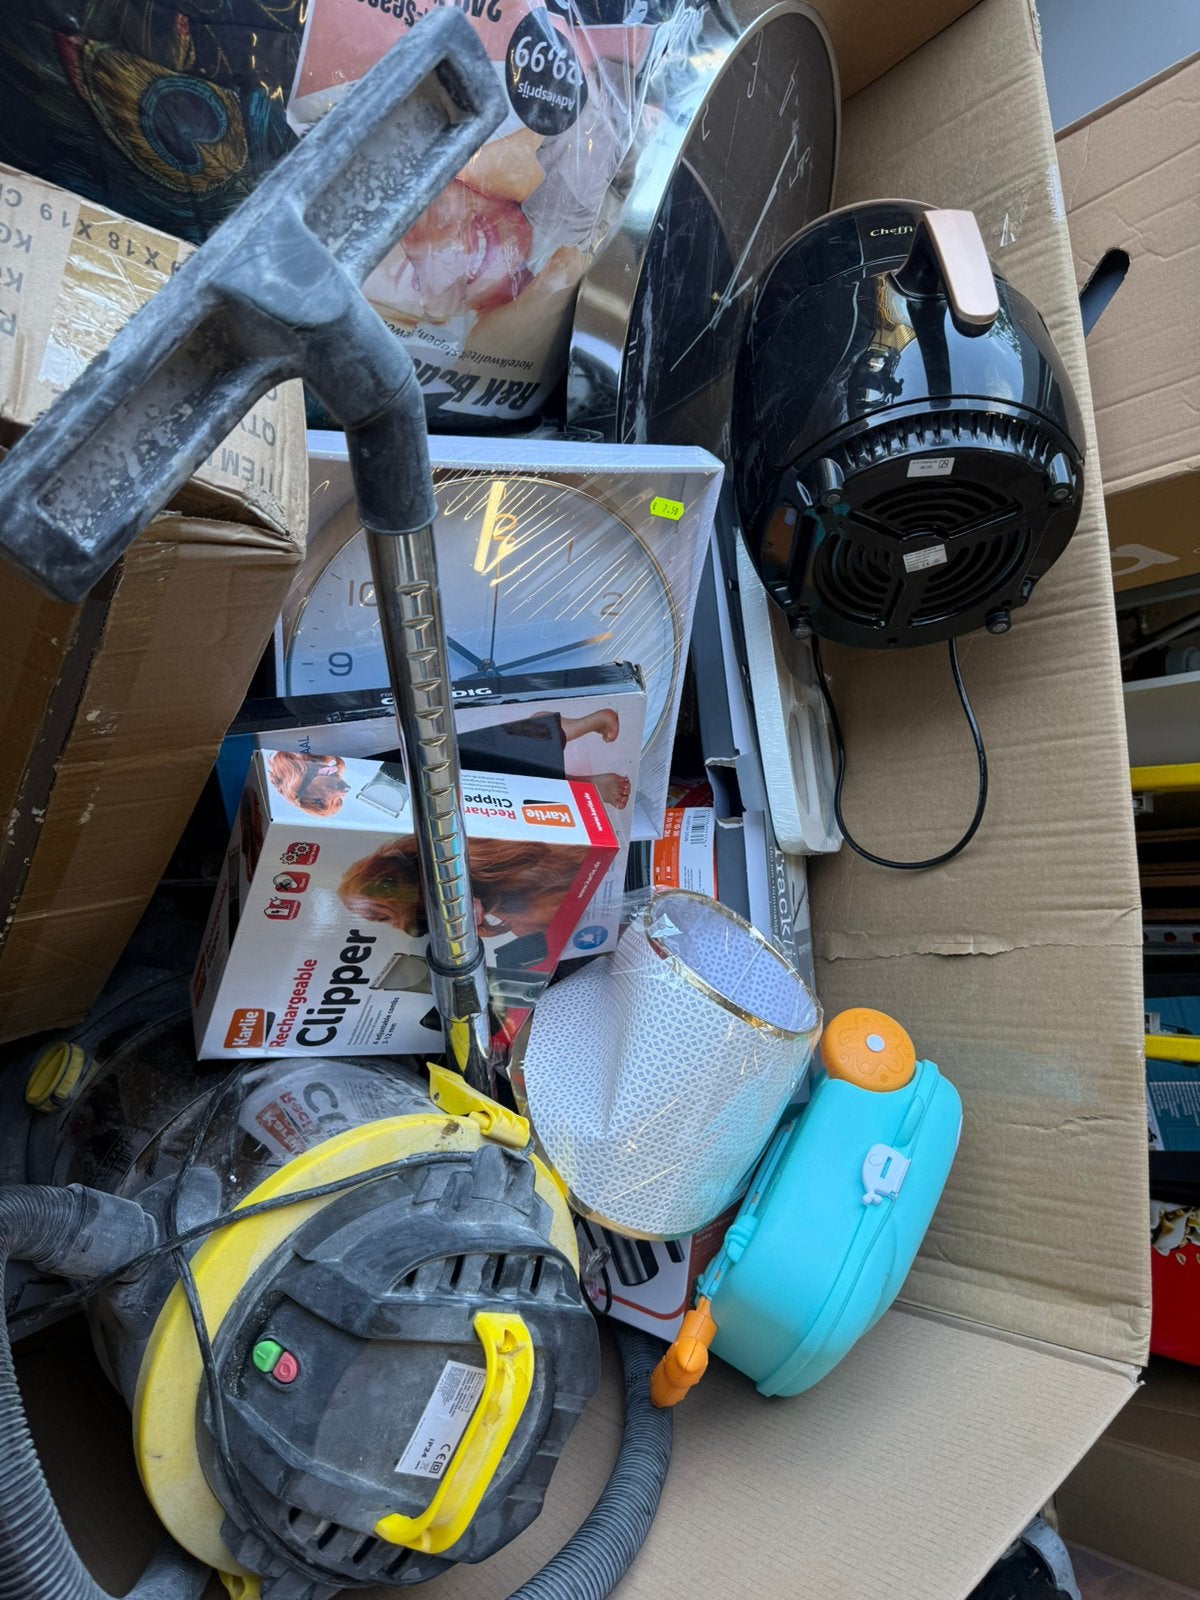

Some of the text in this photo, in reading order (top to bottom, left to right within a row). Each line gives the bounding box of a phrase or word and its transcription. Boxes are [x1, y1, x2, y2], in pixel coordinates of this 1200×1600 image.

[518, 81, 576, 112] Adviesprijs
[0, 184, 23, 207] C
[40, 202, 71, 228] 19
[108, 231, 135, 256] 18
[870, 225, 917, 237] Cheffi
[0, 267, 23, 293] K
[459, 350, 535, 371] Hotelkwaliteit
[471, 377, 541, 411] R&K
[662, 504, 679, 516] 7.50
[600, 592, 624, 616] 2
[328, 652, 353, 676] 9
[526, 808, 571, 823] Karlie
[584, 793, 603, 832] www.karlie.de
[578, 861, 601, 899] www.karlie.de
[774, 846, 796, 961] Trackli
[296, 929, 377, 1047] Clipper
[268, 959, 318, 1048] Rechargeable
[231, 1011, 260, 1047] Karlie
[376, 1015, 392, 1041] adjustable
[388, 997, 400, 1014] combs
[389, 1023, 397, 1033] mm
[421, 1438, 436, 1458] IP24
